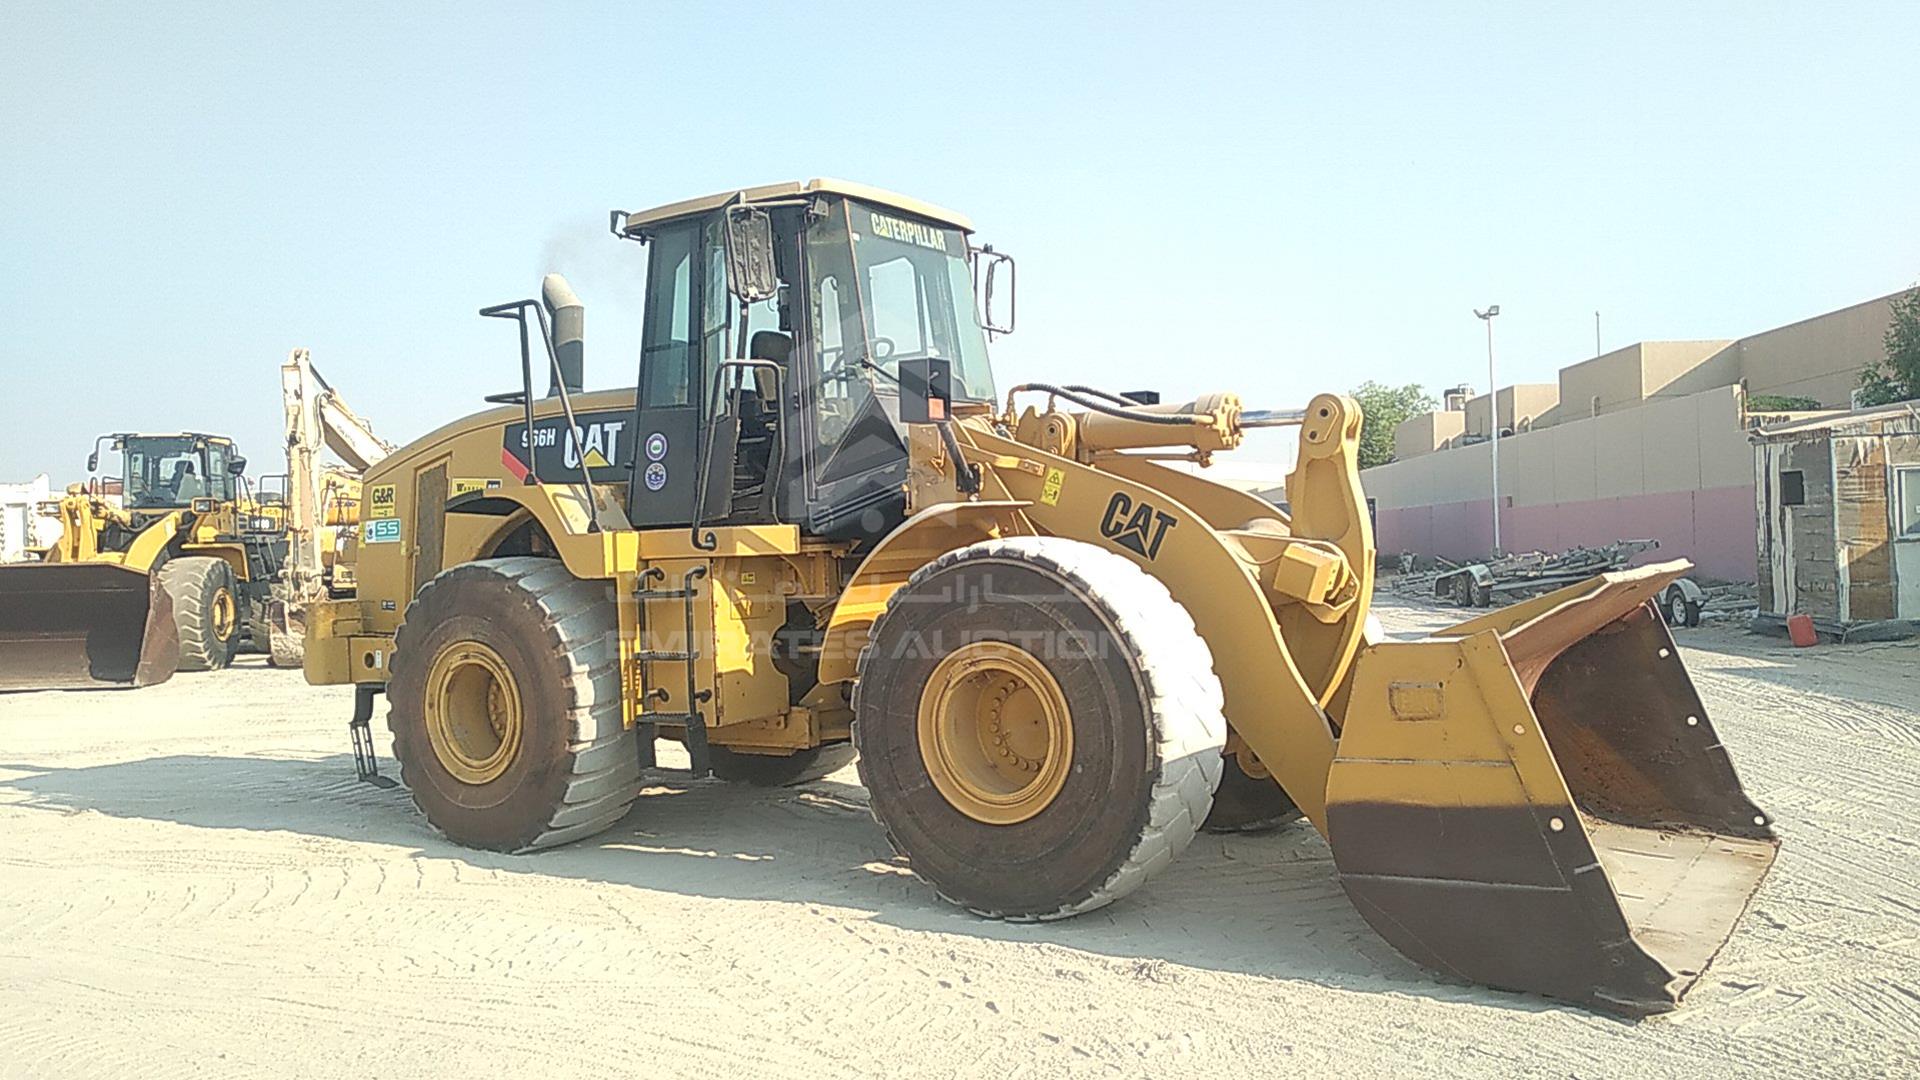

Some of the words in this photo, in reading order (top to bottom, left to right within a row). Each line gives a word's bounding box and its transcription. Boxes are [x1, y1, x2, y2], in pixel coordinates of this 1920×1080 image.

[870, 212, 947, 252] CATERPILLAR
[521, 427, 557, 448] 966H
[563, 422, 623, 469] CAT
[372, 487, 394, 504] G&R
[376, 521, 399, 536] SS
[1100, 491, 1178, 562] CAT
